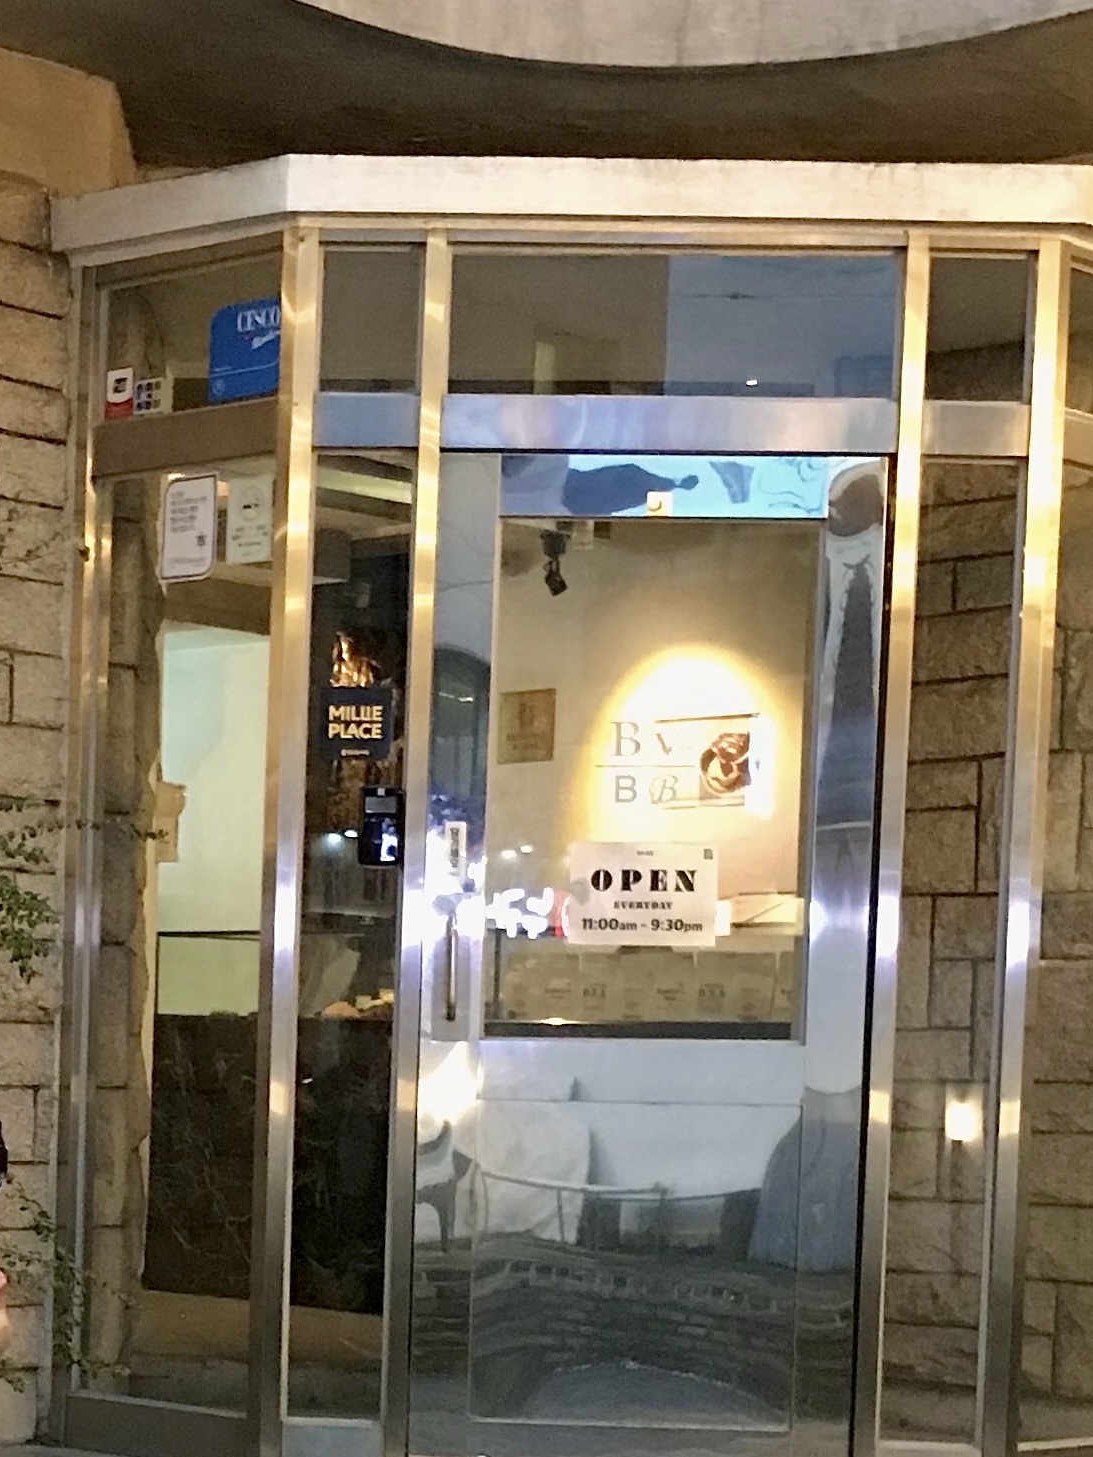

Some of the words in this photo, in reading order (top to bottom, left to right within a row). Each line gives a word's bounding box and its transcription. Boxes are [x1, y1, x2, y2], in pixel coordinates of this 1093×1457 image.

[328, 704, 384, 721] MILLIE
[328, 722, 384, 740] PLACE
[590, 868, 697, 892] OPEN
[613, 901, 673, 910] EVERYDAY
[581, 917, 637, 931] 11:00am
[650, 918, 703, 933] 9:30pm
